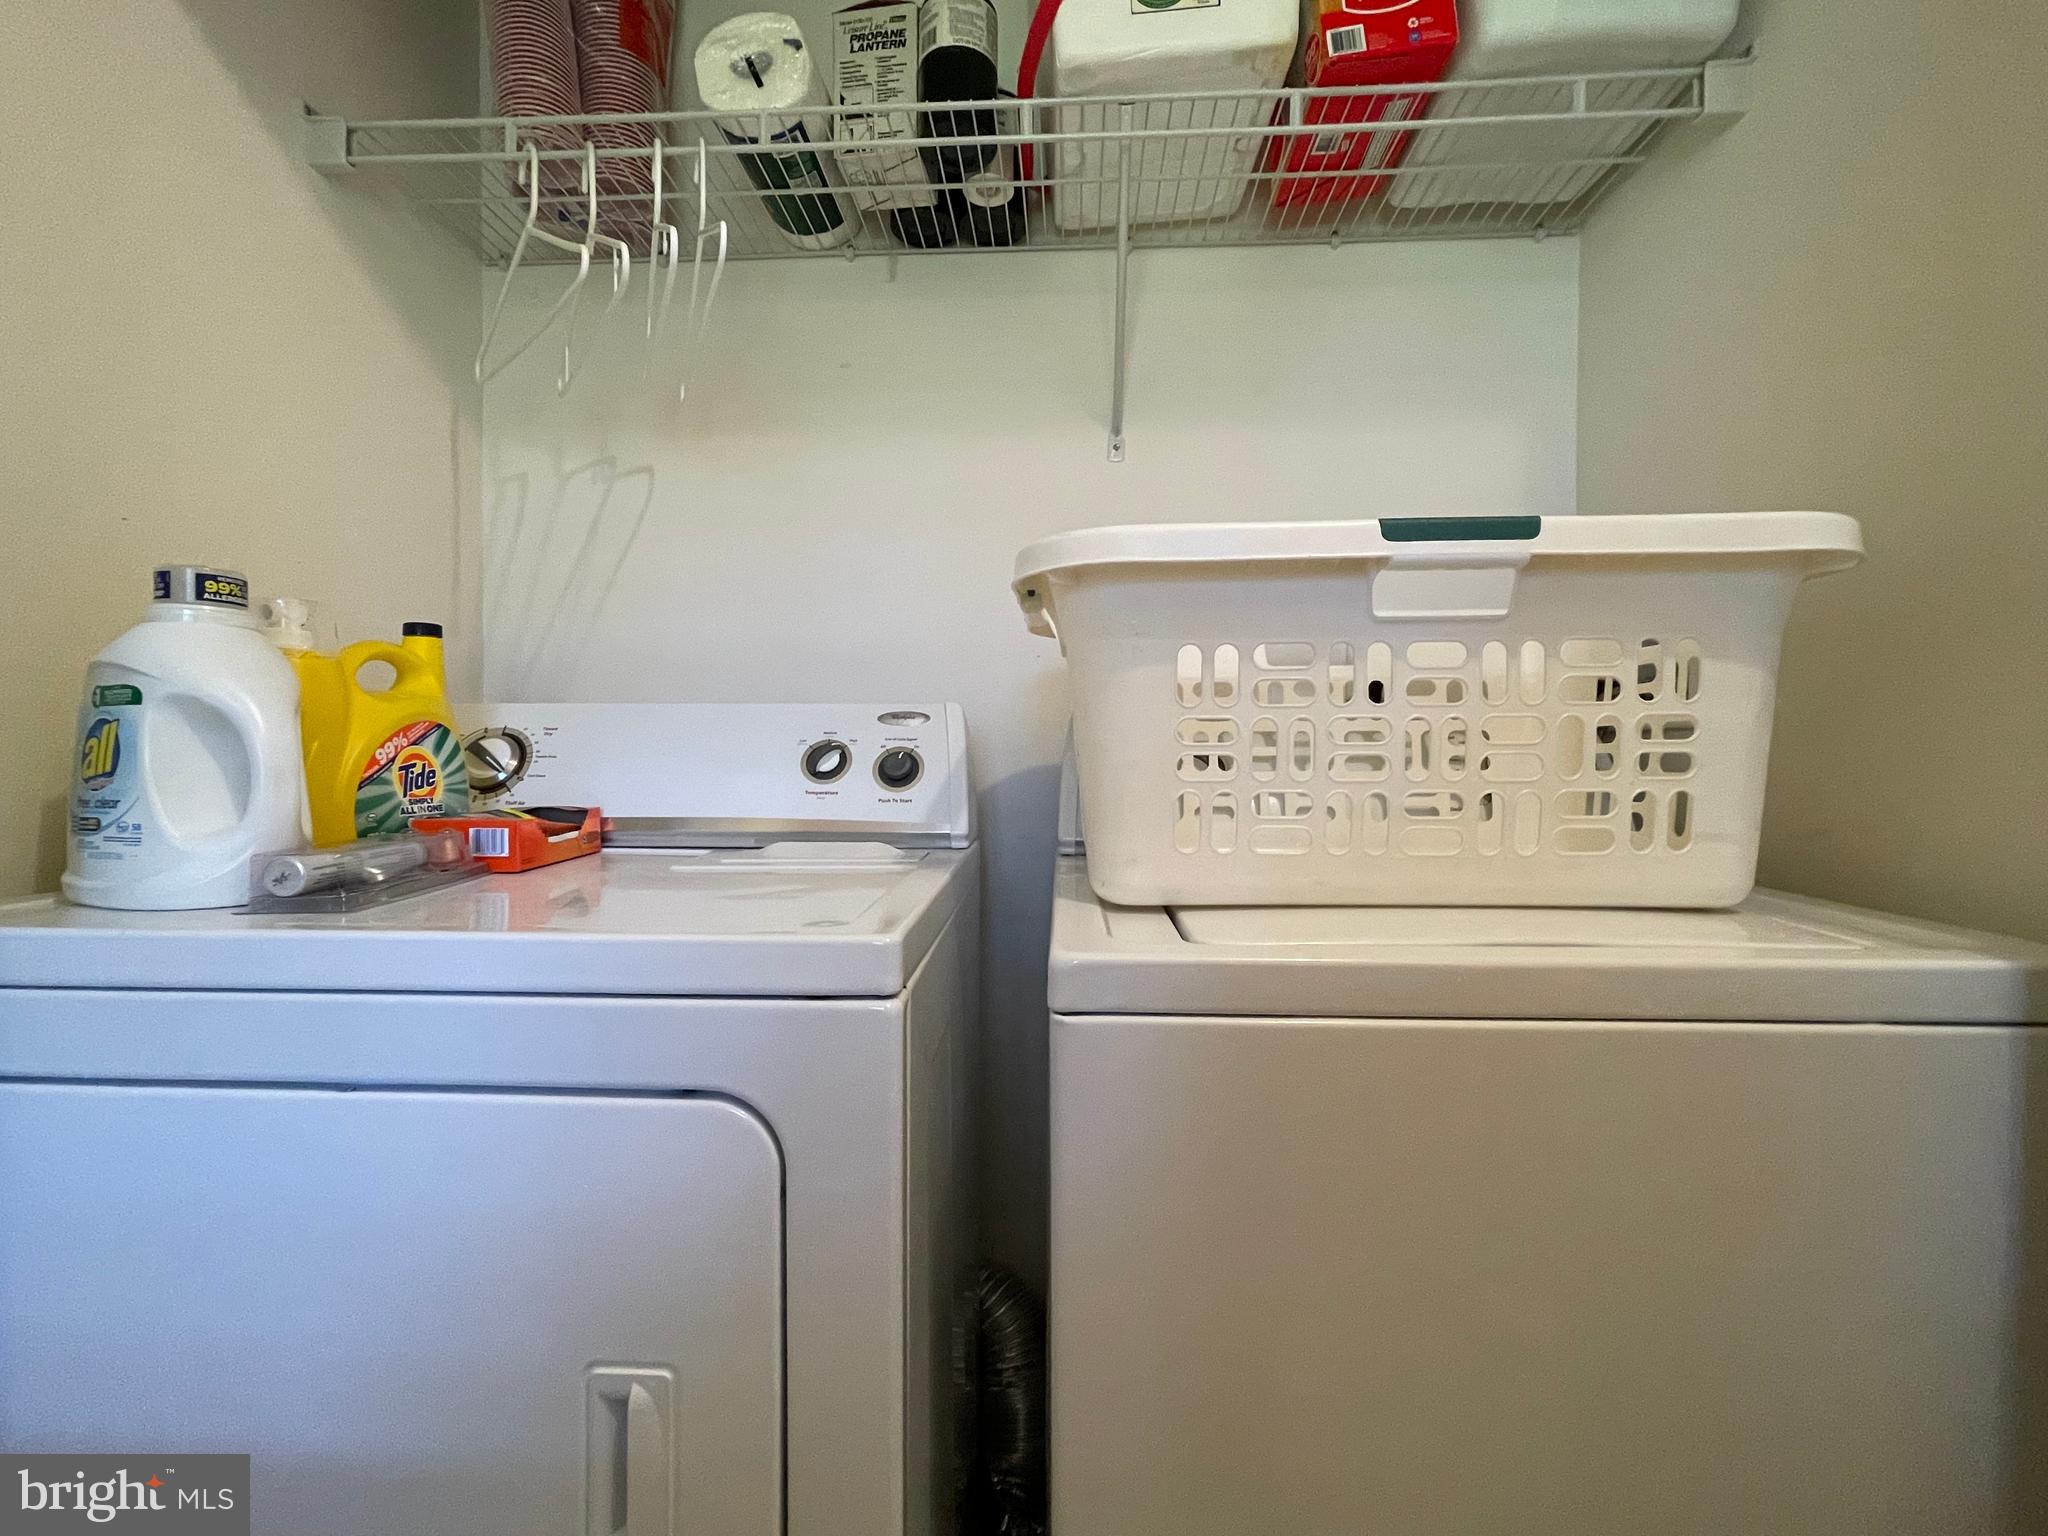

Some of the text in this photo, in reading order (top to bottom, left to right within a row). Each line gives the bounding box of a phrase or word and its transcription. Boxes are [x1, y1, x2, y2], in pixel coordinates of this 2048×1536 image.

[850, 28, 907, 44] PROPANE
[850, 38, 907, 54] LANTERN
[204, 580, 242, 597] 99%
[81, 720, 120, 779] all
[375, 731, 408, 765] 99%
[398, 762, 437, 799] Tide
[400, 807, 417, 815] ALL
[426, 804, 444, 812] ONE
[409, 798, 433, 806] SIMPLY
